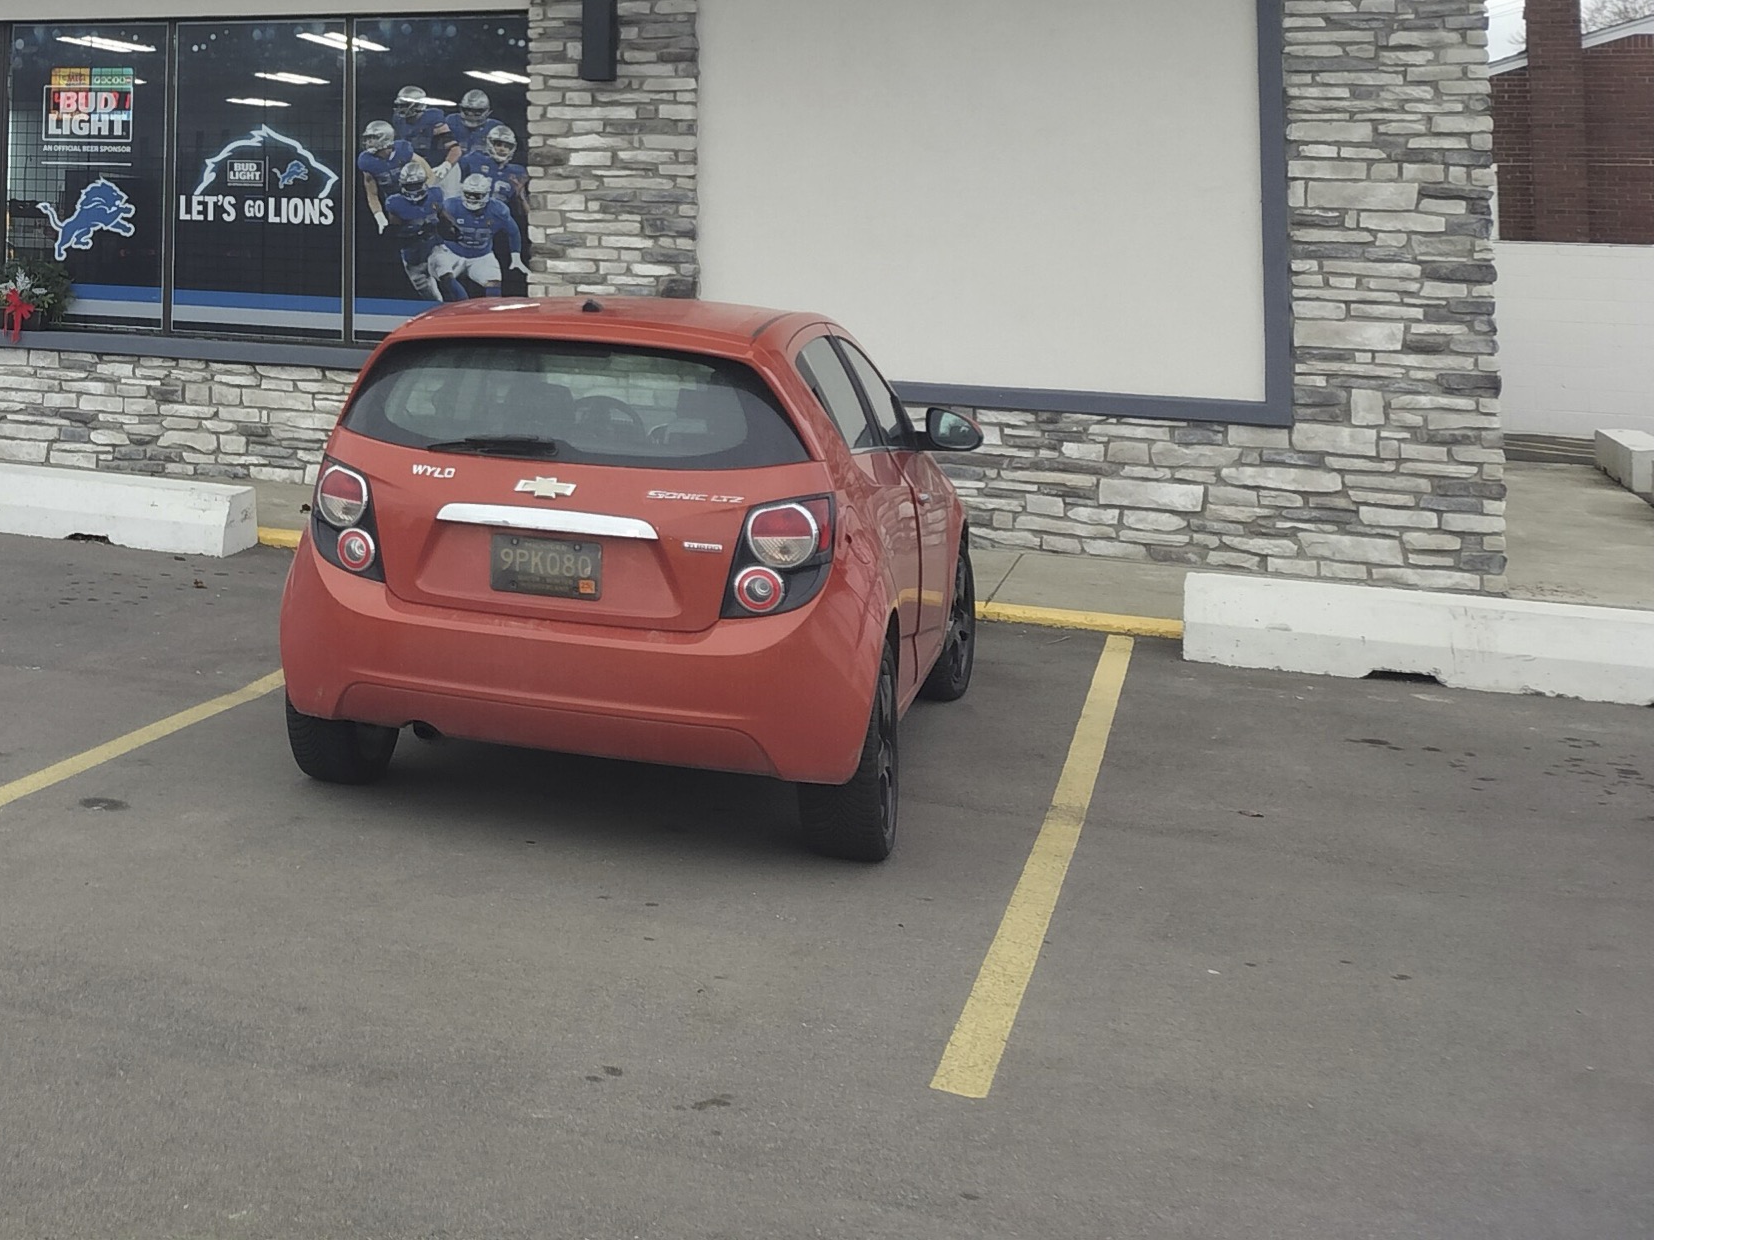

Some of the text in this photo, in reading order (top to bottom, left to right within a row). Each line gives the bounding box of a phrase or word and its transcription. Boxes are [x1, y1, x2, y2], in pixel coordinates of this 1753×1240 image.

[60, 91, 116, 113] BUD
[48, 113, 124, 136] LIGHT
[233, 162, 257, 171] BUD
[229, 171, 261, 181] LIGHT
[179, 194, 335, 225] LET'S GO LIONS
[412, 464, 456, 478] WYLO
[646, 490, 745, 503] SONIC LTZ
